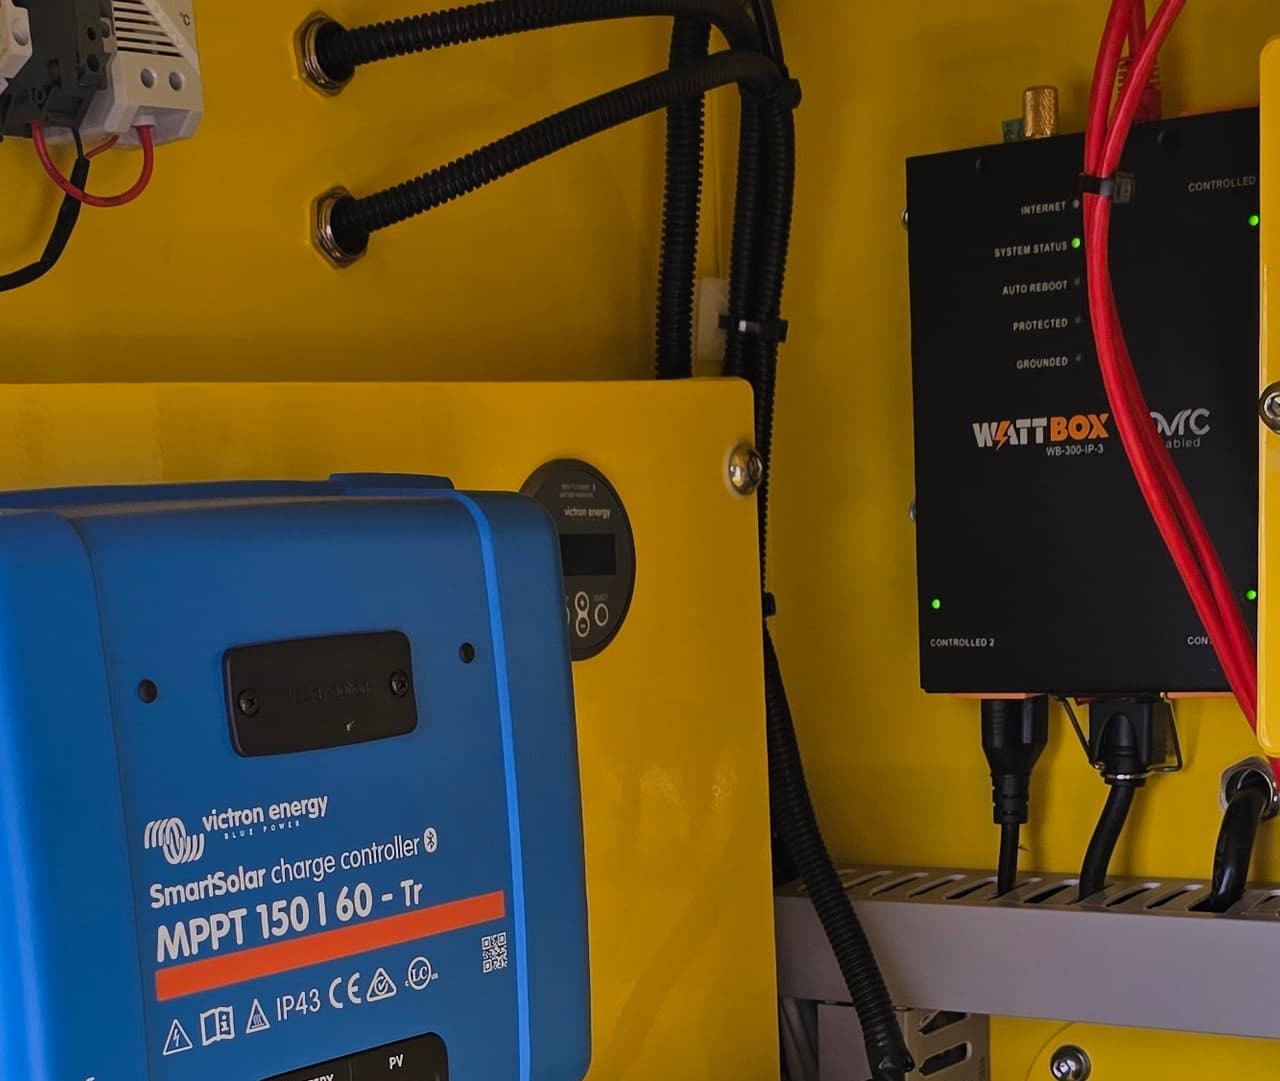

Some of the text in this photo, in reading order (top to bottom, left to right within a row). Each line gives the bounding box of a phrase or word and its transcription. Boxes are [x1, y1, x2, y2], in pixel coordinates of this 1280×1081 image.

[1188, 175, 1256, 193] CONTROLLED
[1021, 201, 1067, 215] INTERNET
[994, 240, 1068, 258] SYSTEM STATUS
[1002, 280, 1068, 296] AUTO REBOOT
[1013, 318, 1068, 332] PROTECTED
[1016, 356, 1069, 370] GROUNDED
[972, 413, 1109, 450] WATTBOX
[1046, 444, 1104, 457] WB-300-IP-3
[930, 637, 995, 648] CONTROLLED 2
[202, 796, 328, 832] victron energy
[224, 820, 301, 840] BLUE POWER
[150, 834, 419, 908] SmartSolar charge controller
[156, 908, 247, 962] MPPT
[256, 896, 310, 939] 150
[336, 882, 372, 921] 60
[400, 879, 423, 907] Tr
[277, 988, 320, 1021] IP43
[389, 1054, 404, 1070] PV
